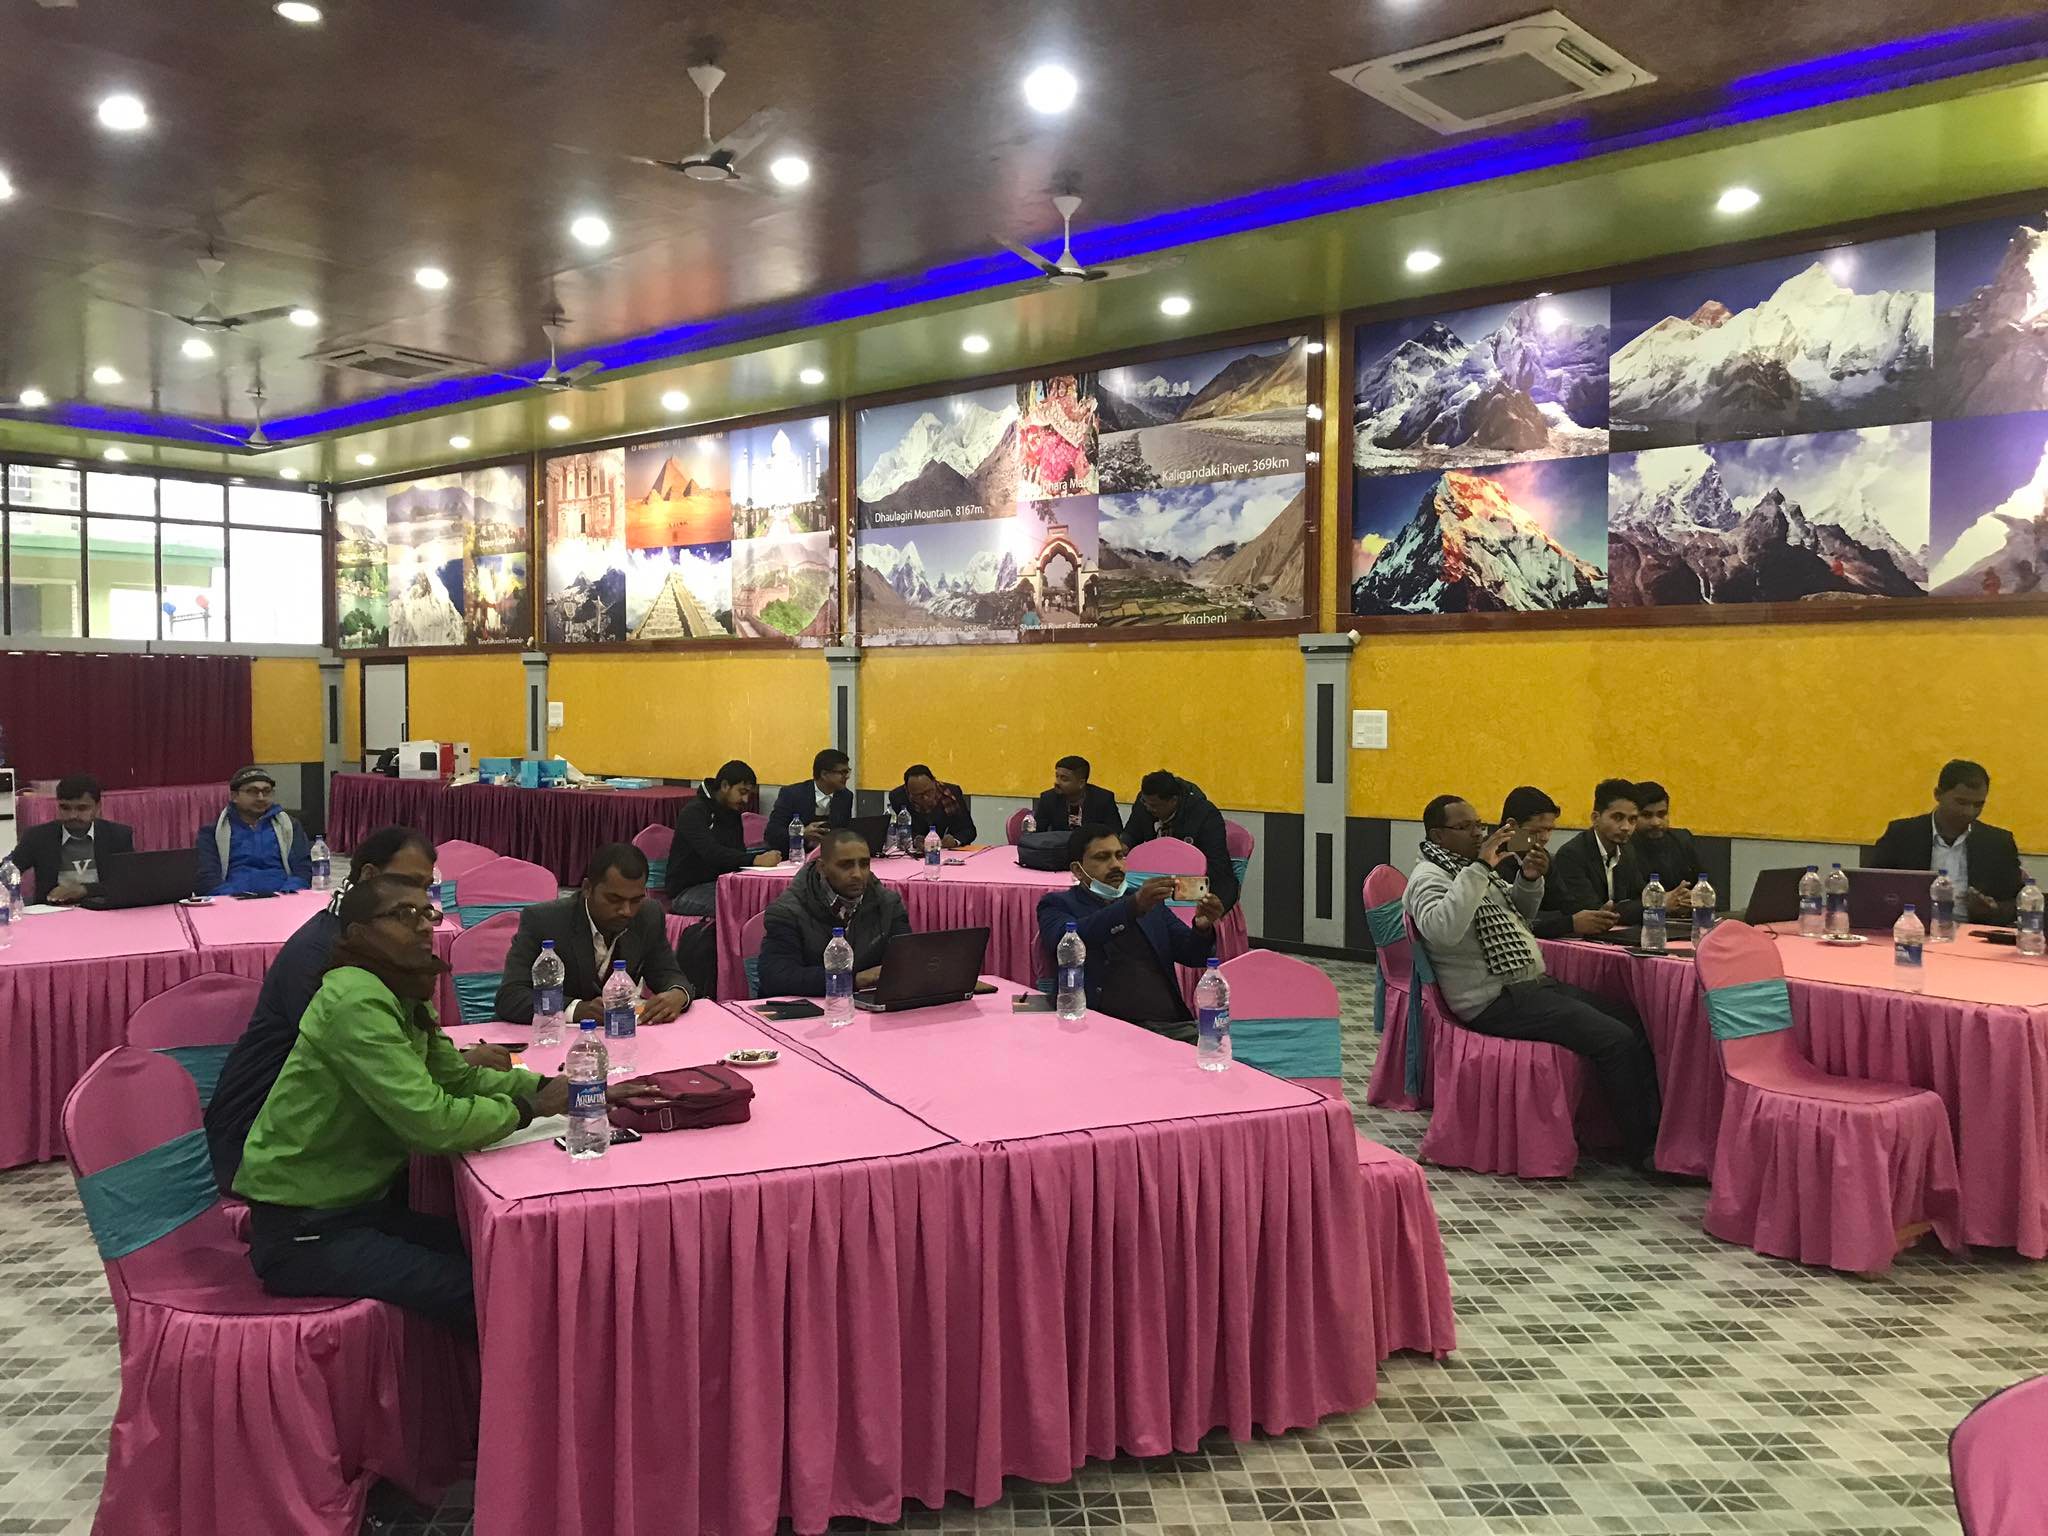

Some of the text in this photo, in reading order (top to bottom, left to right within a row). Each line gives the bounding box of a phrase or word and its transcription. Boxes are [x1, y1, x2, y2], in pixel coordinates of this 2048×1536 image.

[1161, 456, 1289, 482] Kaligandaki River, 369km
[874, 504, 985, 523] Dhaulagiri Mountain, 8167m.
